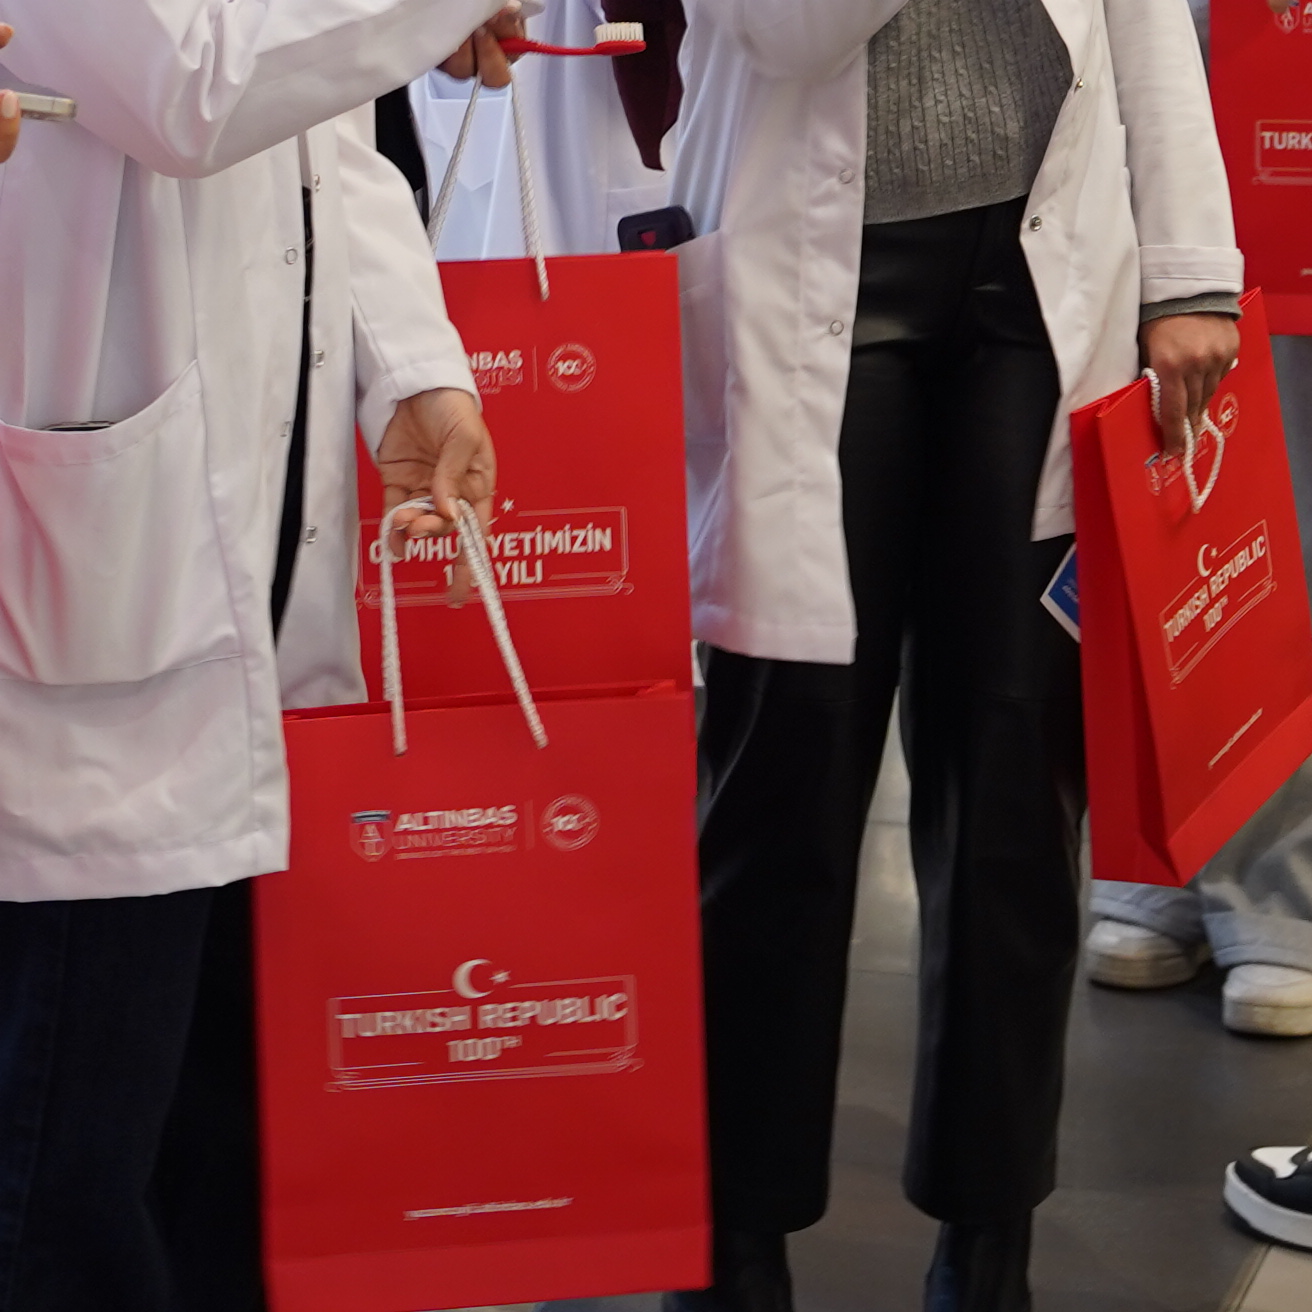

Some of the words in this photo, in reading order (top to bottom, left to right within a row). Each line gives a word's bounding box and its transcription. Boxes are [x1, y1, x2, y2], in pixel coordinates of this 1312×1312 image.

[495, 559, 544, 587] YILI
[1163, 584, 1211, 642] TURKISH
[1209, 535, 1267, 599] REPUBLIC
[334, 1005, 472, 1039] TURKISH
[477, 992, 629, 1030] REPUBLIC
